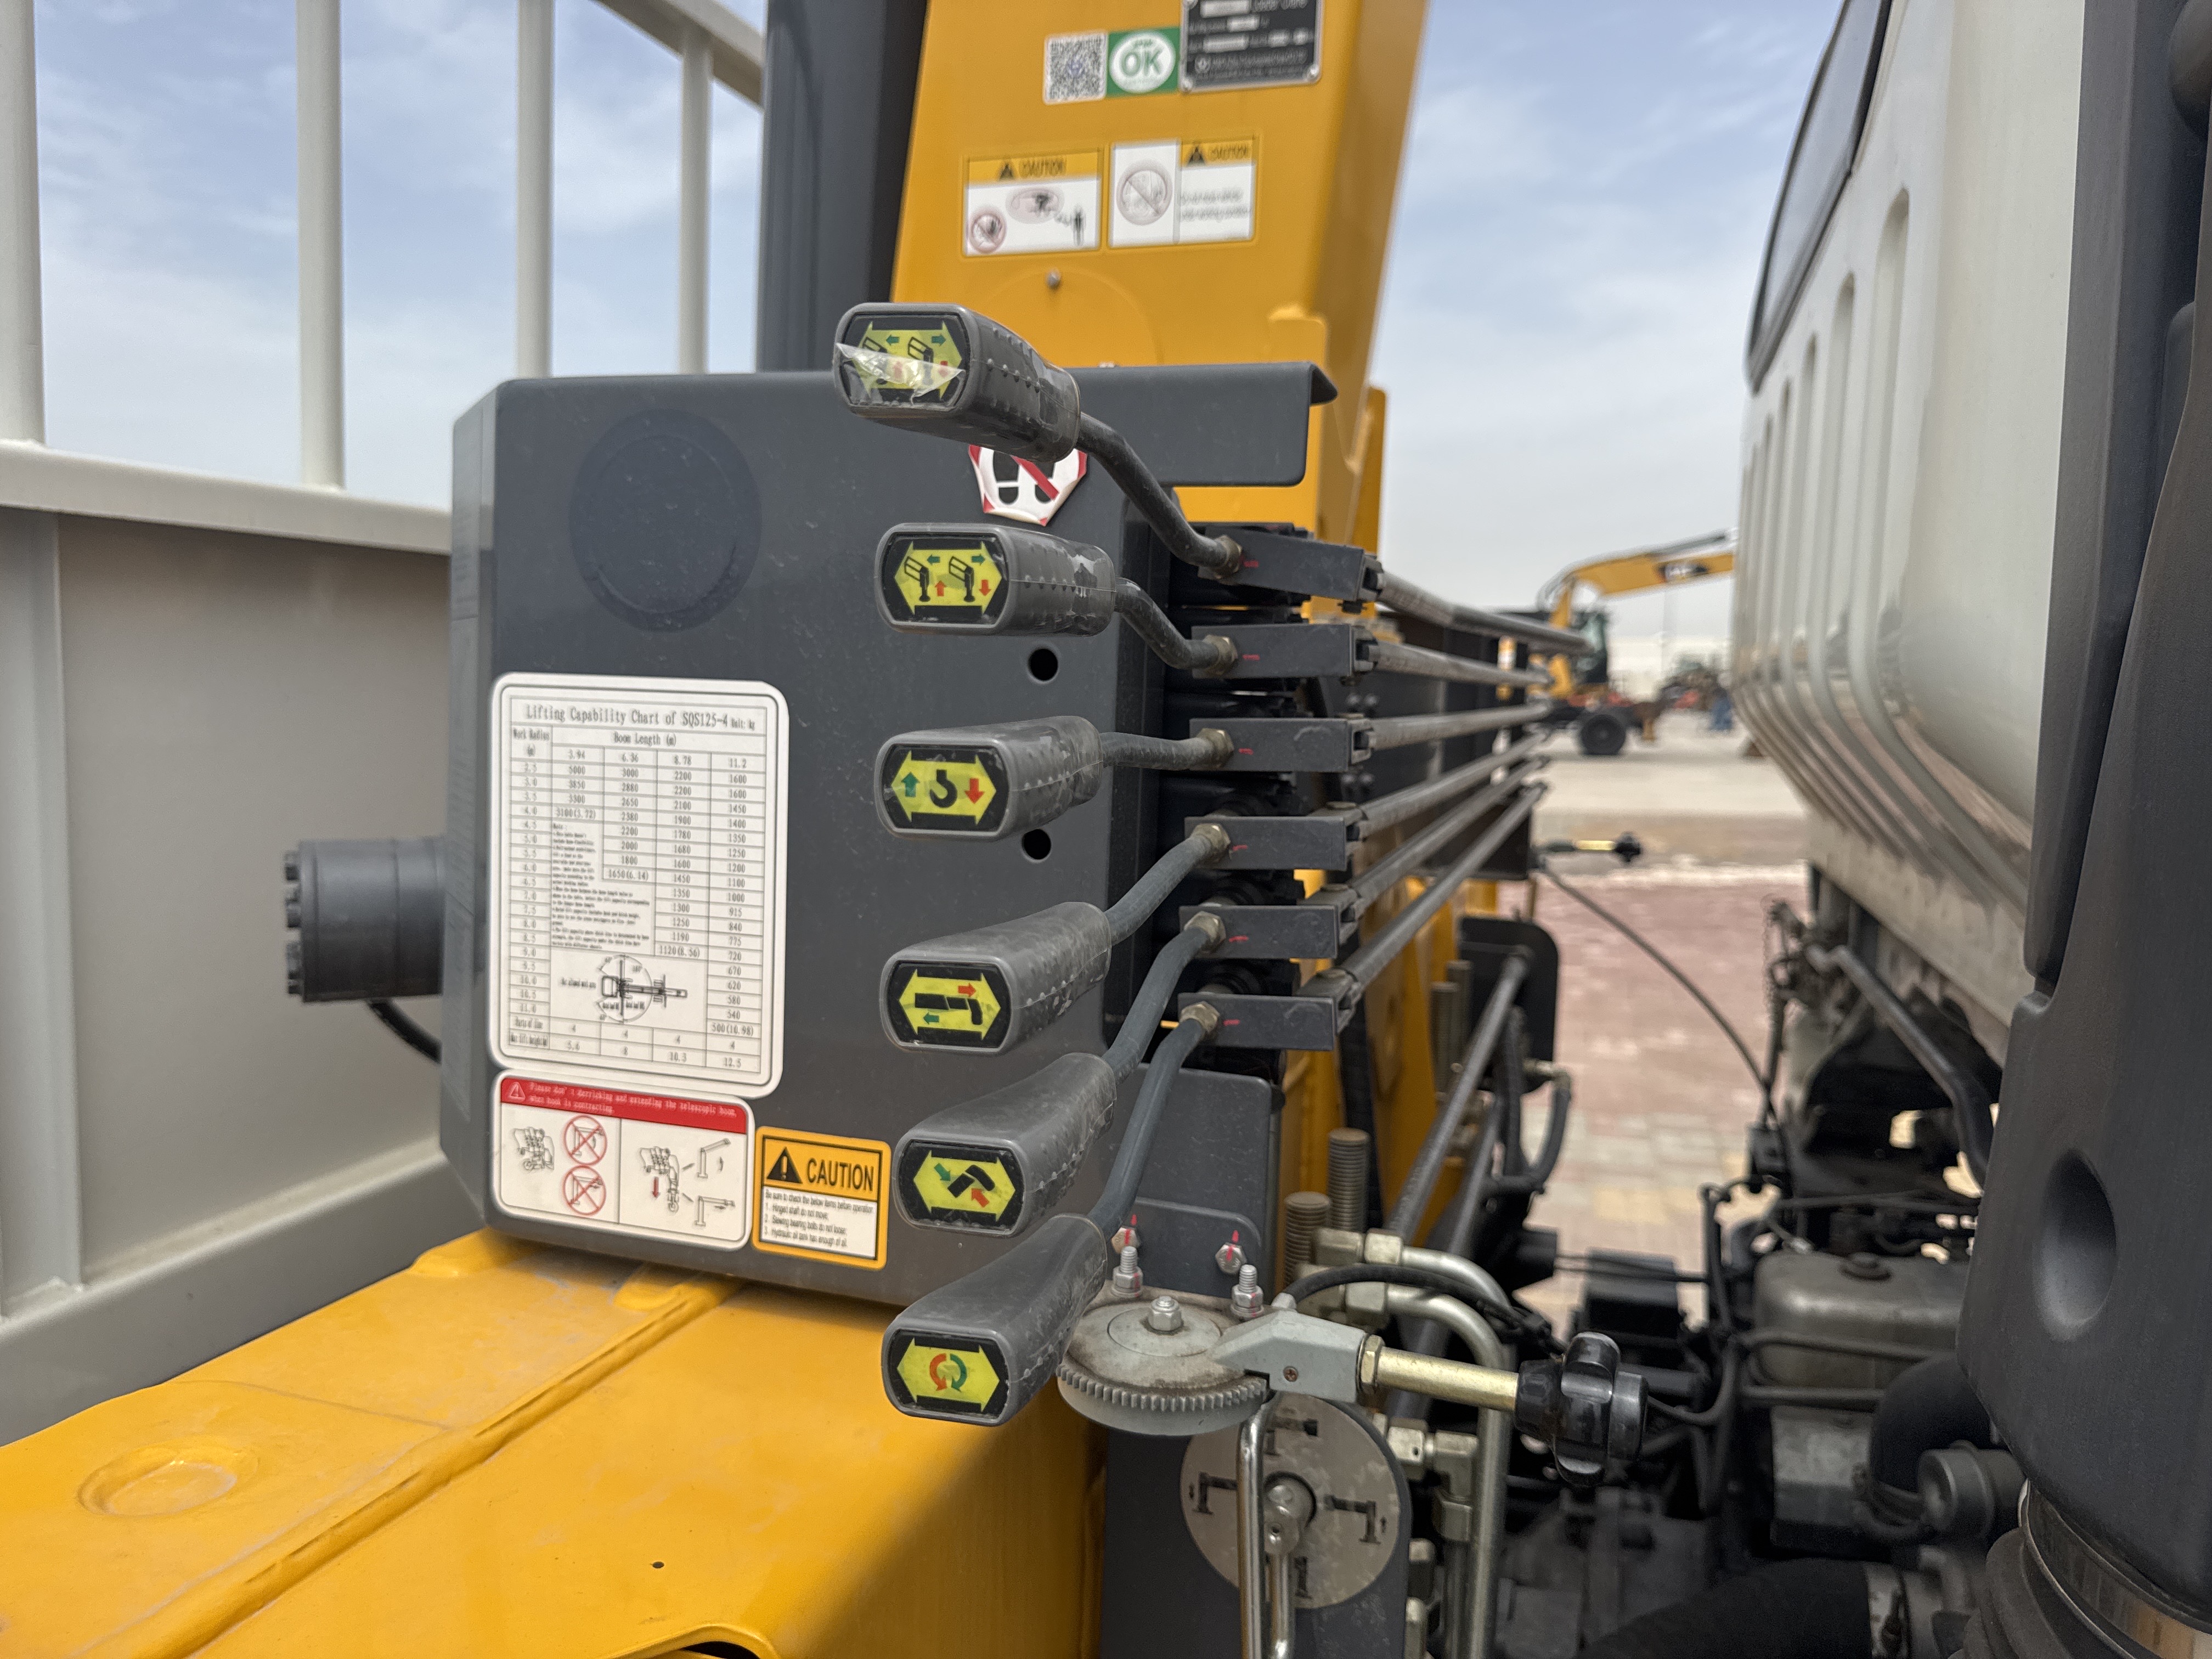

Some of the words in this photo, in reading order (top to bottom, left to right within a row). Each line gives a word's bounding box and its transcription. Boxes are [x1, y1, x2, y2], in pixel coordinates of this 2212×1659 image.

[1120, 48, 1163, 77] OK
[526, 704, 565, 723] Lifting
[570, 706, 626, 725] Capability
[631, 708, 658, 724] Chart
[665, 711, 676, 725] of
[682, 712, 728, 728] SQS125-4
[614, 731, 631, 744] Boom
[635, 732, 661, 746] Length
[673, 755, 692, 765] 8.78
[729, 758, 747, 769] 11.2
[674, 771, 692, 781] 2200
[729, 775, 748, 785] 1600
[674, 786, 692, 796] 2200
[729, 789, 747, 799] 1600
[674, 801, 692, 811] 2100
[729, 804, 747, 814] 1450
[674, 815, 691, 825] 1900
[729, 819, 747, 828] 1400
[673, 830, 691, 840] 1780
[728, 833, 747, 844] 1350
[673, 844, 691, 855] 1680
[728, 849, 746, 859] 1250
[673, 859, 691, 869] 1600
[727, 863, 746, 873] 1200
[673, 873, 691, 884] 1450
[727, 878, 746, 888] 1100
[673, 888, 691, 898] 1350
[727, 892, 746, 902] 1000
[672, 902, 690, 912] 1300
[729, 907, 743, 917] 915
[672, 917, 690, 928] 1250
[728, 922, 743, 932] 840
[672, 932, 690, 942] 1190
[728, 936, 742, 946] 775
[727, 951, 742, 961] 720
[727, 966, 742, 975] 670
[727, 980, 742, 990] 620
[727, 995, 741, 1005] 580
[726, 1010, 741, 1020] 540
[807, 1157, 874, 1191] CAUTION
